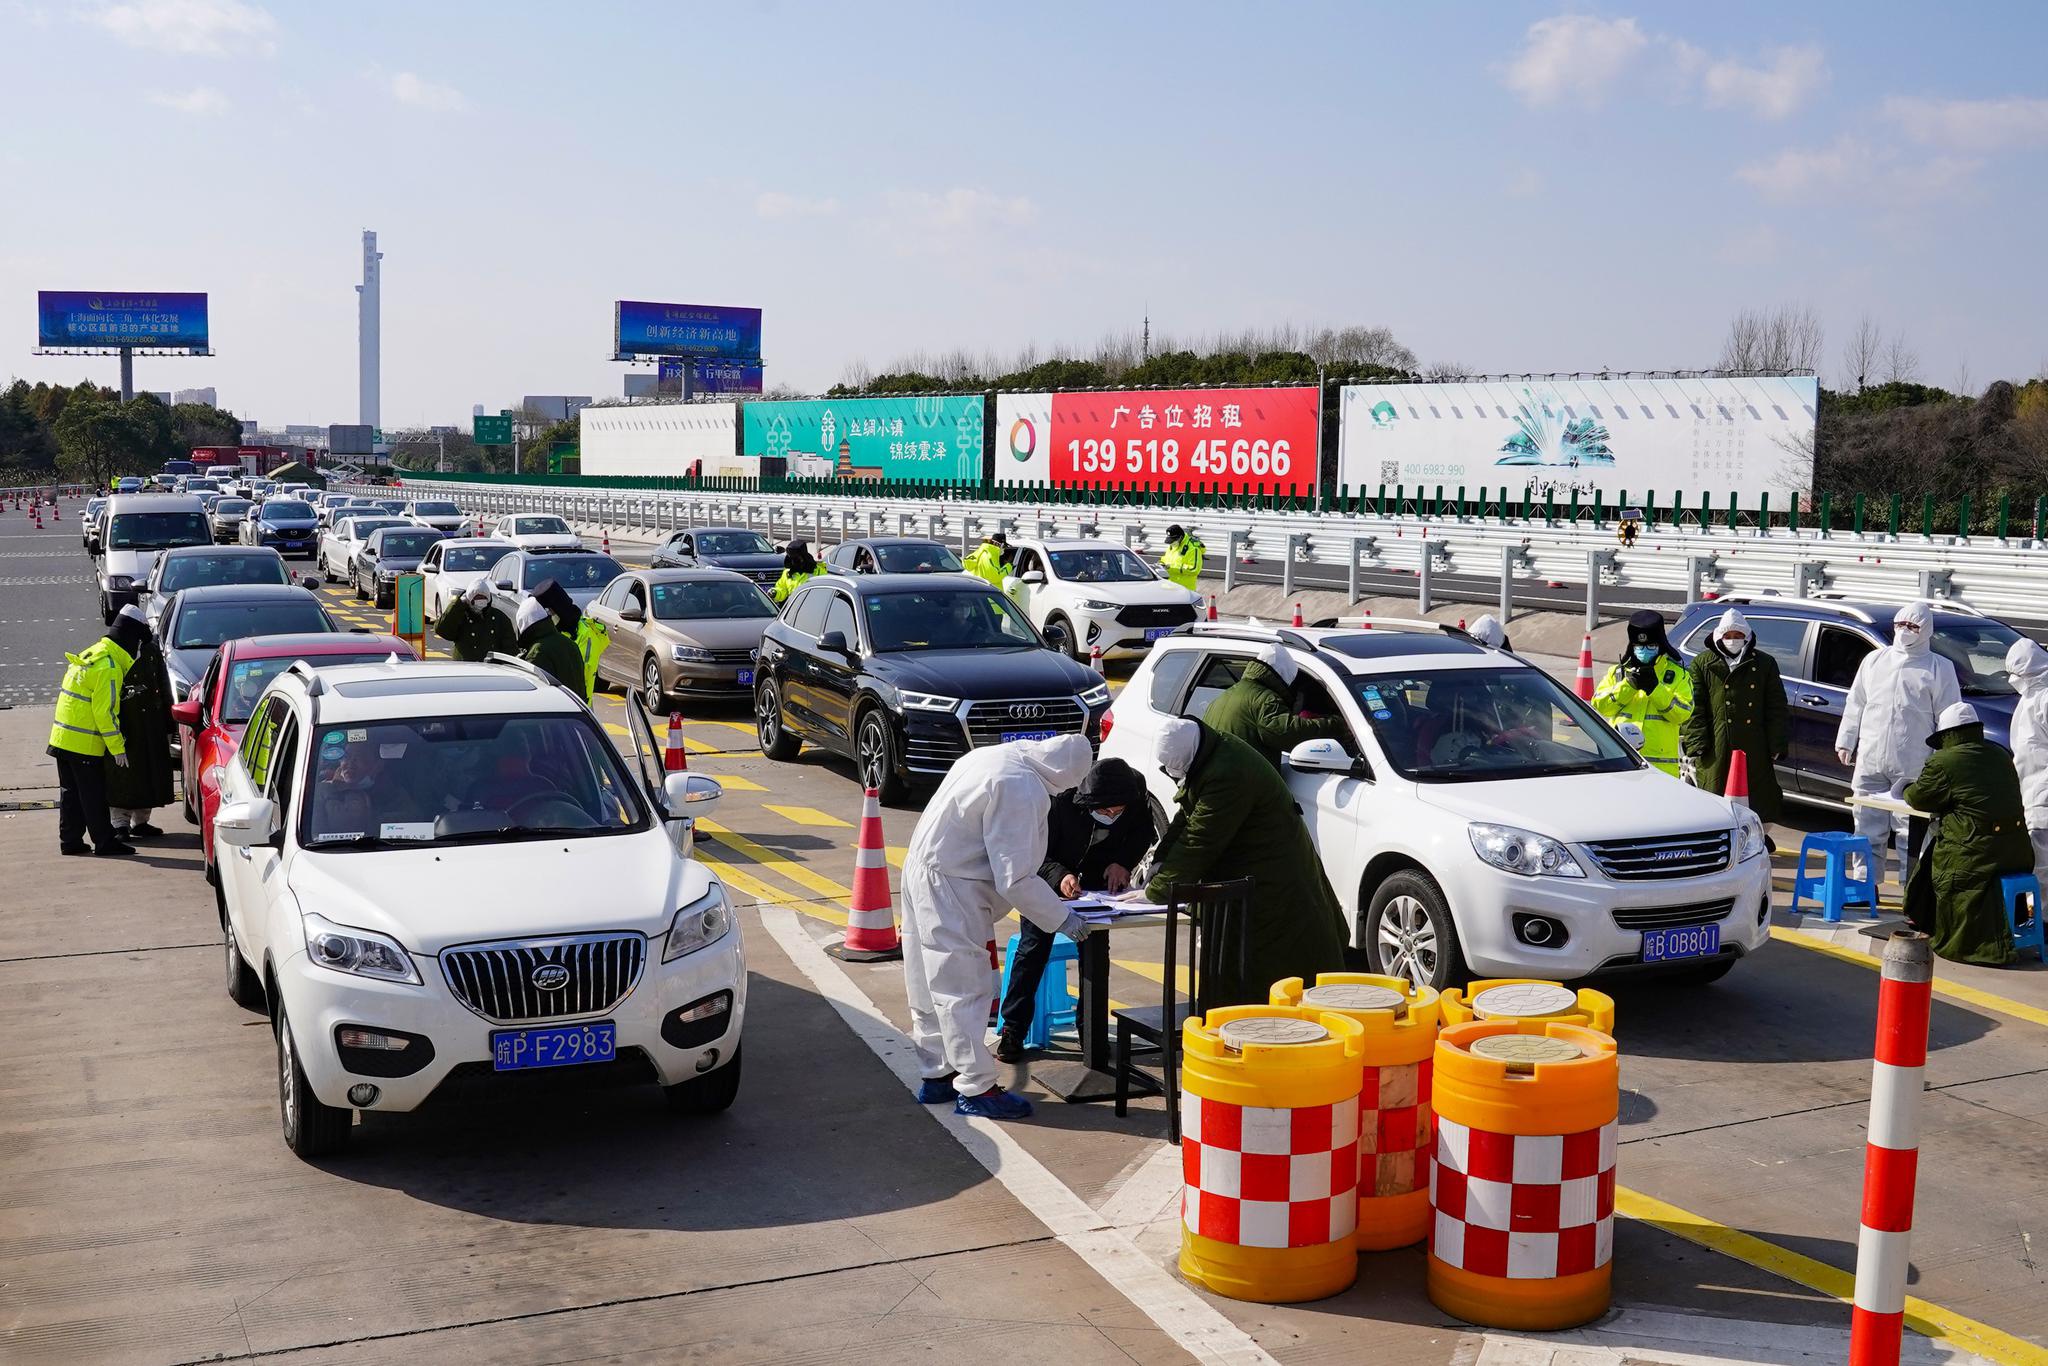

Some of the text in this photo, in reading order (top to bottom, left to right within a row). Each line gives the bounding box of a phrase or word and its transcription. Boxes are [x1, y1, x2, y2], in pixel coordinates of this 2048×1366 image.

[646, 324, 737, 341] 创新经济新高地
[665, 368, 700, 379] 开文车
[1110, 404, 1242, 429] 广告位招租
[849, 418, 904, 437] 丝绸小镇
[889, 441, 947, 461] 锦绣震泽
[1068, 439, 1291, 476] 139 518 45666
[1404, 463, 1465, 476] 400 6982 990
[1656, 849, 1693, 860] HAVAL
